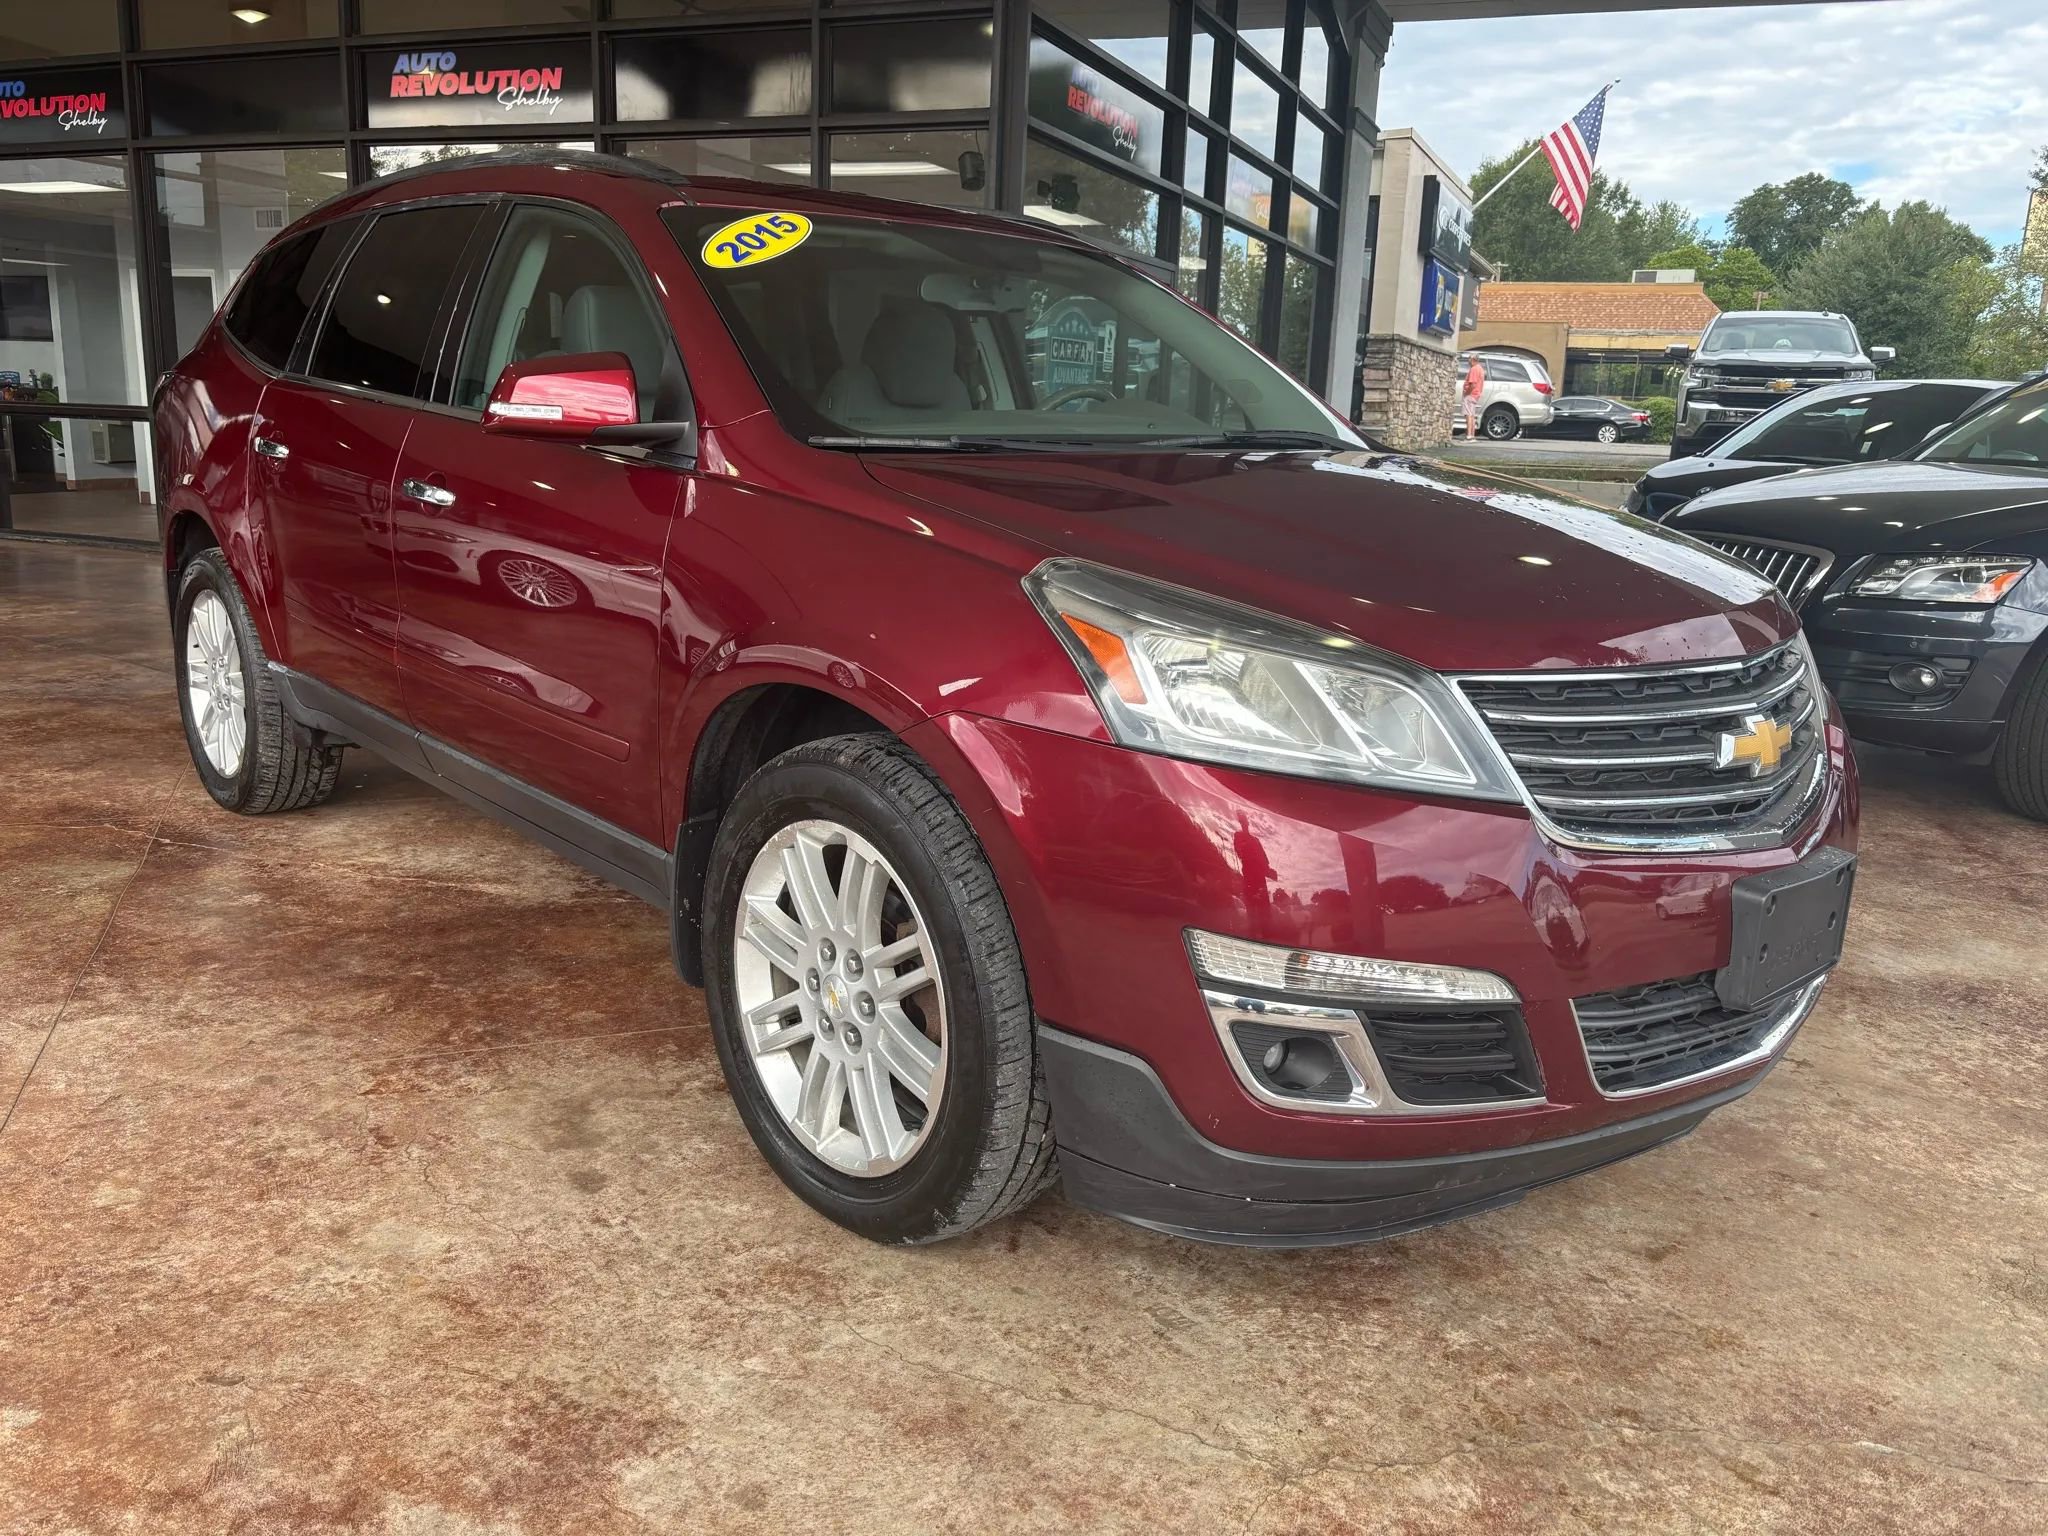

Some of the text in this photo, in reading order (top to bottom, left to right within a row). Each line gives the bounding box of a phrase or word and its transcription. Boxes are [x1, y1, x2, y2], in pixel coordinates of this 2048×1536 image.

[393, 51, 456, 74] AUTO
[0, 80, 26, 97] TO
[390, 67, 563, 98] REVOLUTION
[0, 92, 106, 118] VOLUTION
[497, 84, 564, 115] Shelby
[1066, 85, 1137, 138] REVOLUTION
[58, 107, 108, 134] Shelby
[1112, 125, 1137, 160] Shelby
[716, 215, 799, 264] 2015
[1052, 341, 1094, 365] CARFAX
